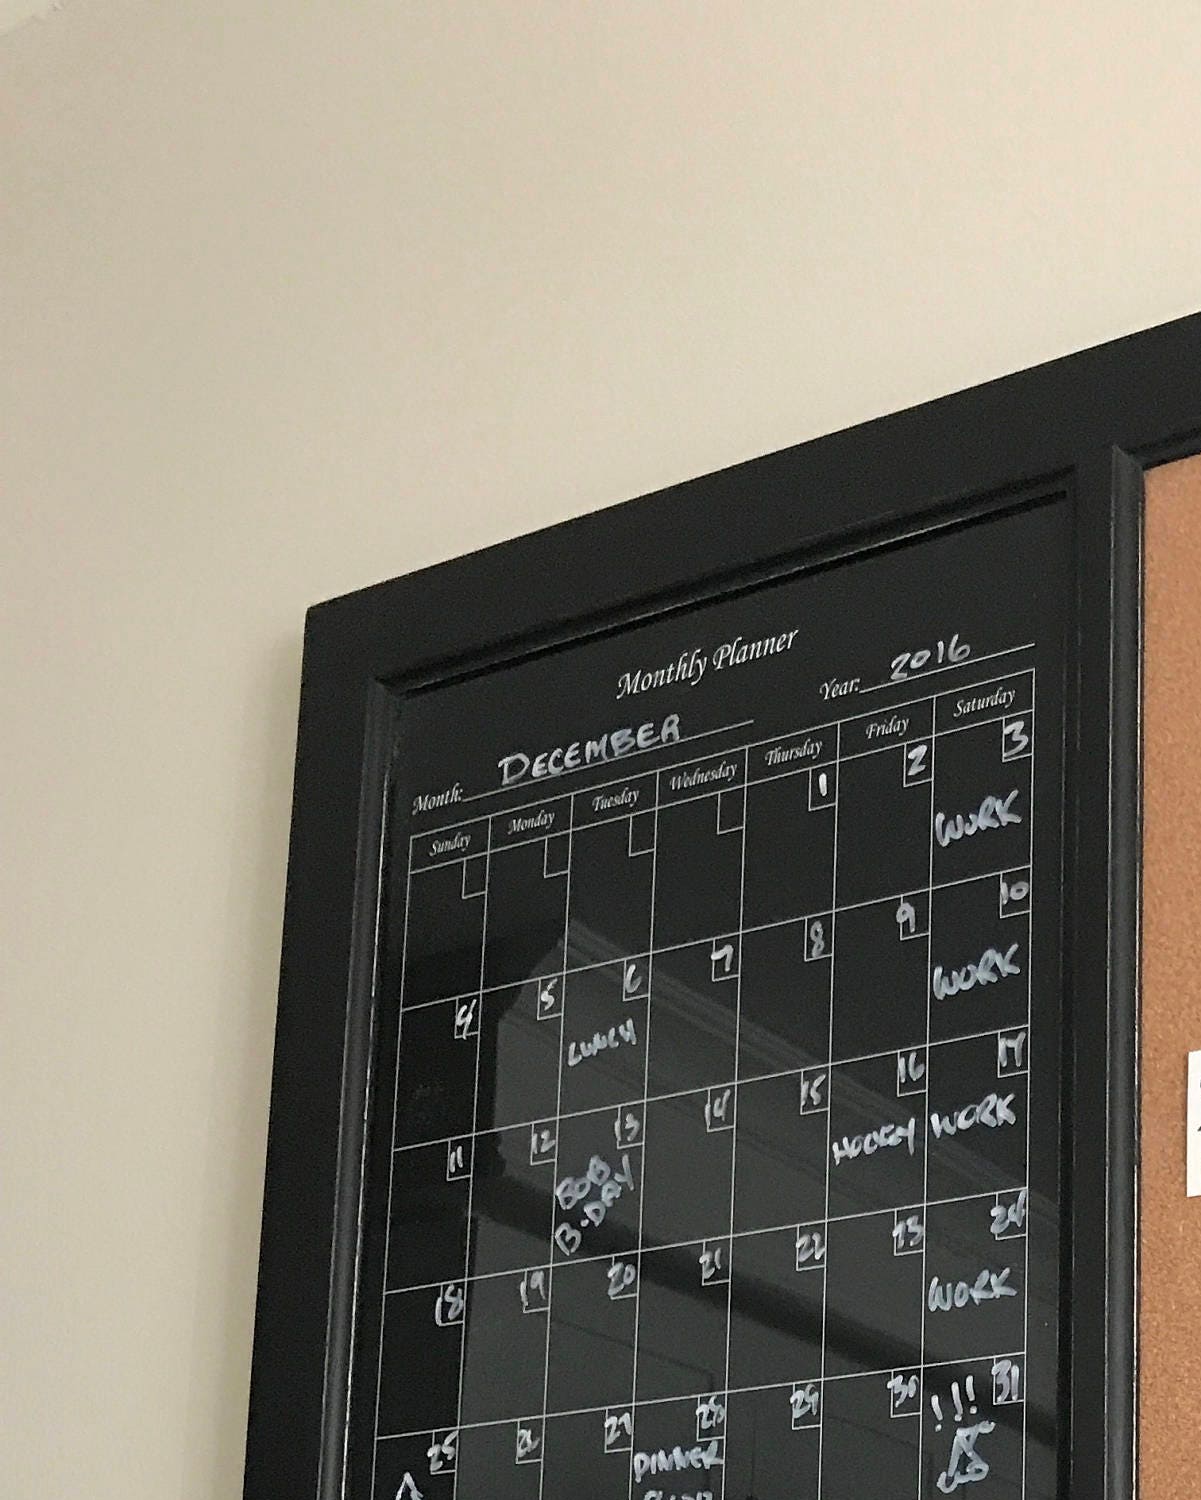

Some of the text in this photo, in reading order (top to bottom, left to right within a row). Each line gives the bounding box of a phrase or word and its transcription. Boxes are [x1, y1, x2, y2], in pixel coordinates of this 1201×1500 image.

[616, 628, 799, 699] Monthly Planner
[890, 633, 971, 681] 2016
[819, 678, 861, 702] Year:
[954, 687, 1016, 717] Saturday
[866, 715, 909, 740] Friday
[1003, 720, 1029, 758] 3
[498, 713, 680, 786] DECEMBER
[765, 738, 822, 766] Thursday
[908, 745, 927, 776] 2
[669, 760, 737, 791] Wednesday
[819, 772, 828, 797] 1
[412, 782, 464, 815] Month:
[592, 787, 639, 812] Tuesday
[507, 810, 555, 835] Monday
[935, 789, 1023, 848] WORK
[429, 832, 471, 857] Sunday
[1000, 880, 1030, 906] 10
[896, 902, 916, 933] 9
[810, 920, 825, 958] 8
[711, 944, 734, 972] 7
[934, 943, 1020, 1000] WORK
[540, 978, 558, 1010] 5
[625, 964, 643, 994] 6
[456, 998, 477, 1040] 4
[898, 1051, 925, 1083] 16
[800, 1074, 826, 1108] 15
[615, 1112, 640, 1142] 13
[931, 1093, 1017, 1140] WORK
[531, 1129, 556, 1154] 12
[450, 1145, 463, 1174] 11
[606, 1261, 636, 1298] 20
[699, 1247, 721, 1280] 21
[519, 1270, 546, 1307] 19
[928, 1266, 1018, 1313] WORK
[887, 1373, 919, 1408] 30
[990, 1358, 1020, 1402] 31
